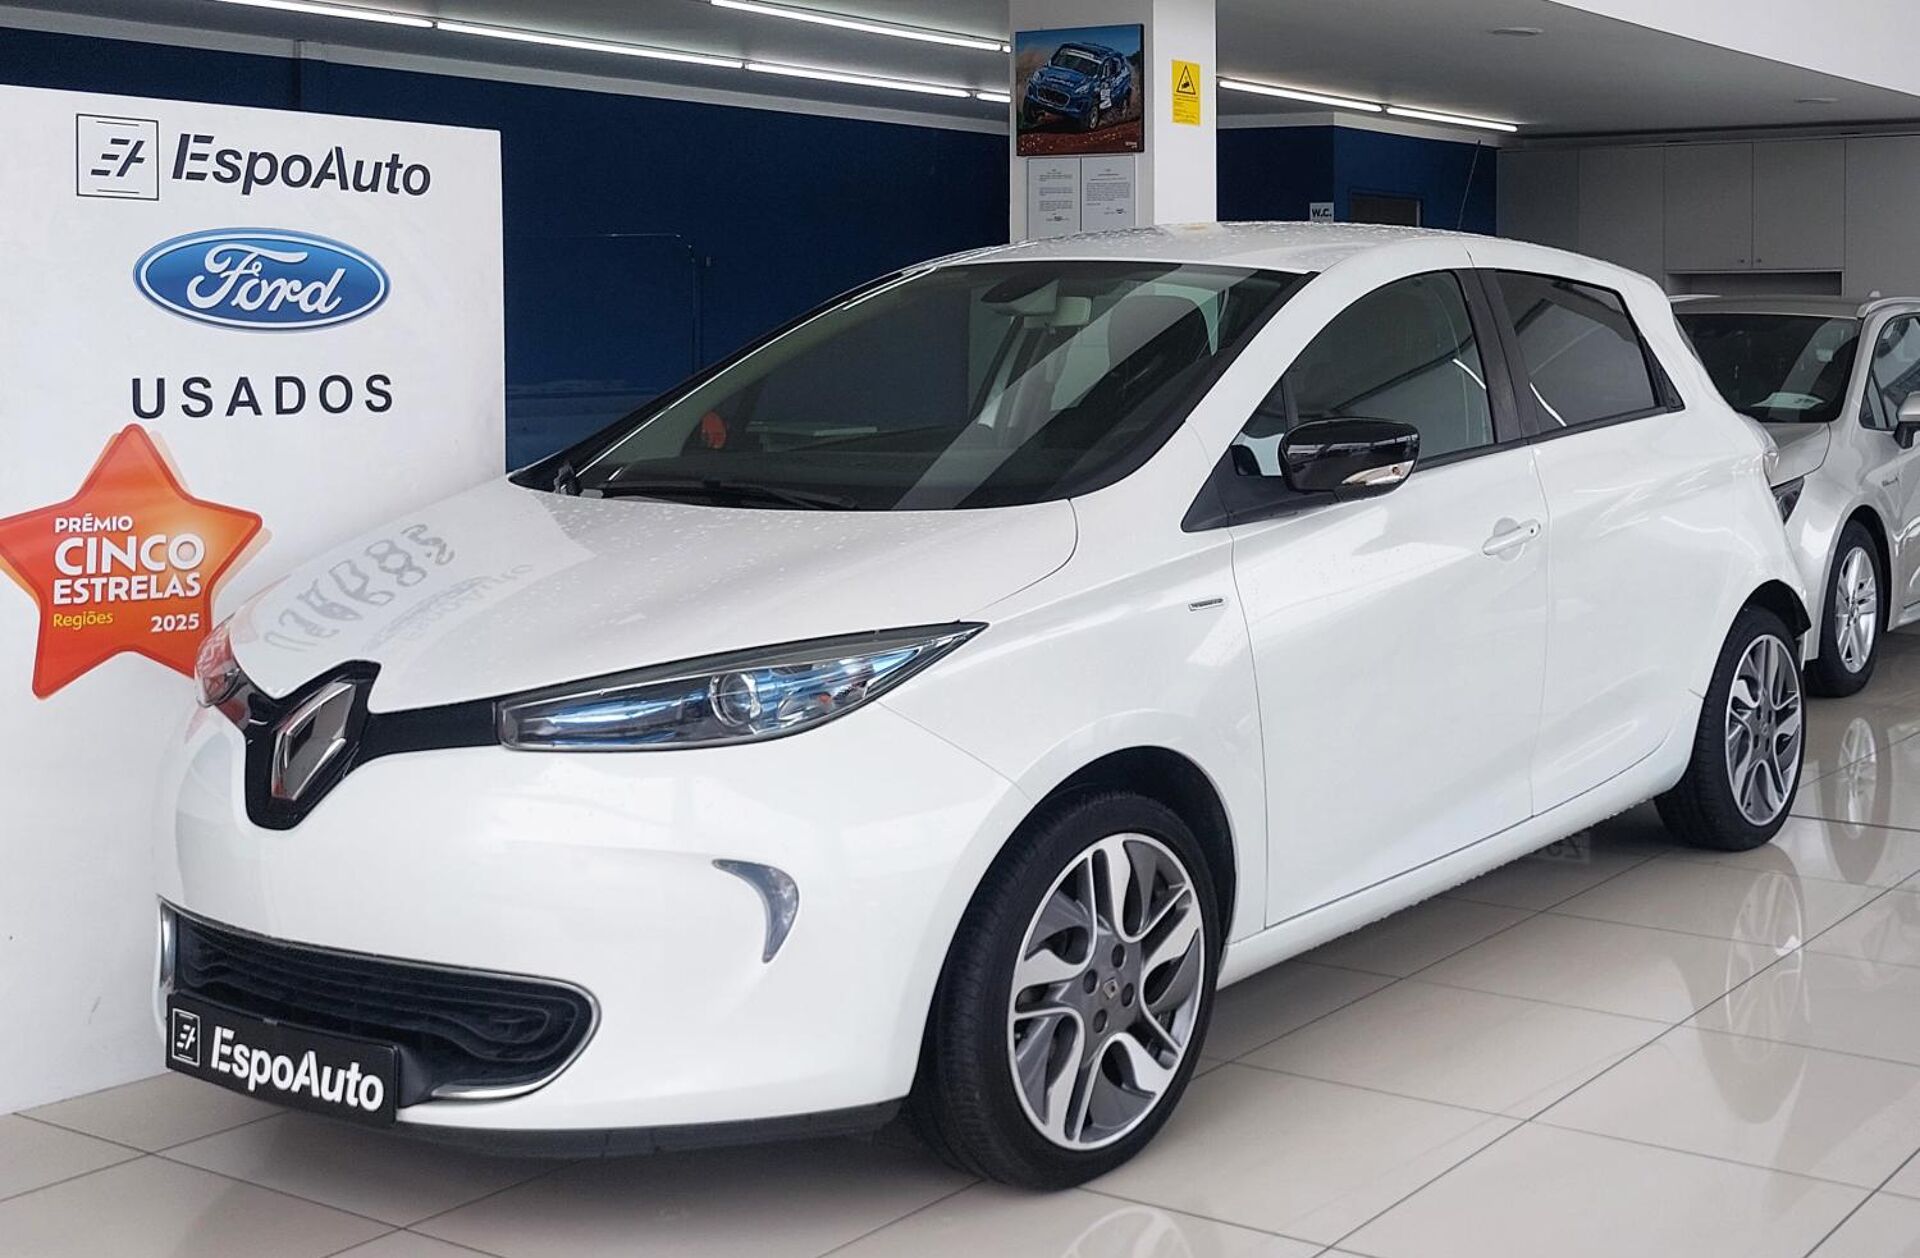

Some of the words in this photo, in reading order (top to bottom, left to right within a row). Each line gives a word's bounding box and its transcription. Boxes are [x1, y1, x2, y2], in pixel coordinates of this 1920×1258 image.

[172, 133, 432, 197] EspoAuto
[187, 243, 343, 315] Ford
[132, 374, 394, 420] USADOS
[54, 513, 133, 533] PRÉMIO
[54, 533, 206, 576] CINCO
[53, 573, 202, 605] ESTRELAS
[53, 610, 114, 631] Regiões
[150, 613, 200, 633] 2025
[210, 1026, 385, 1113] EspoAuto
